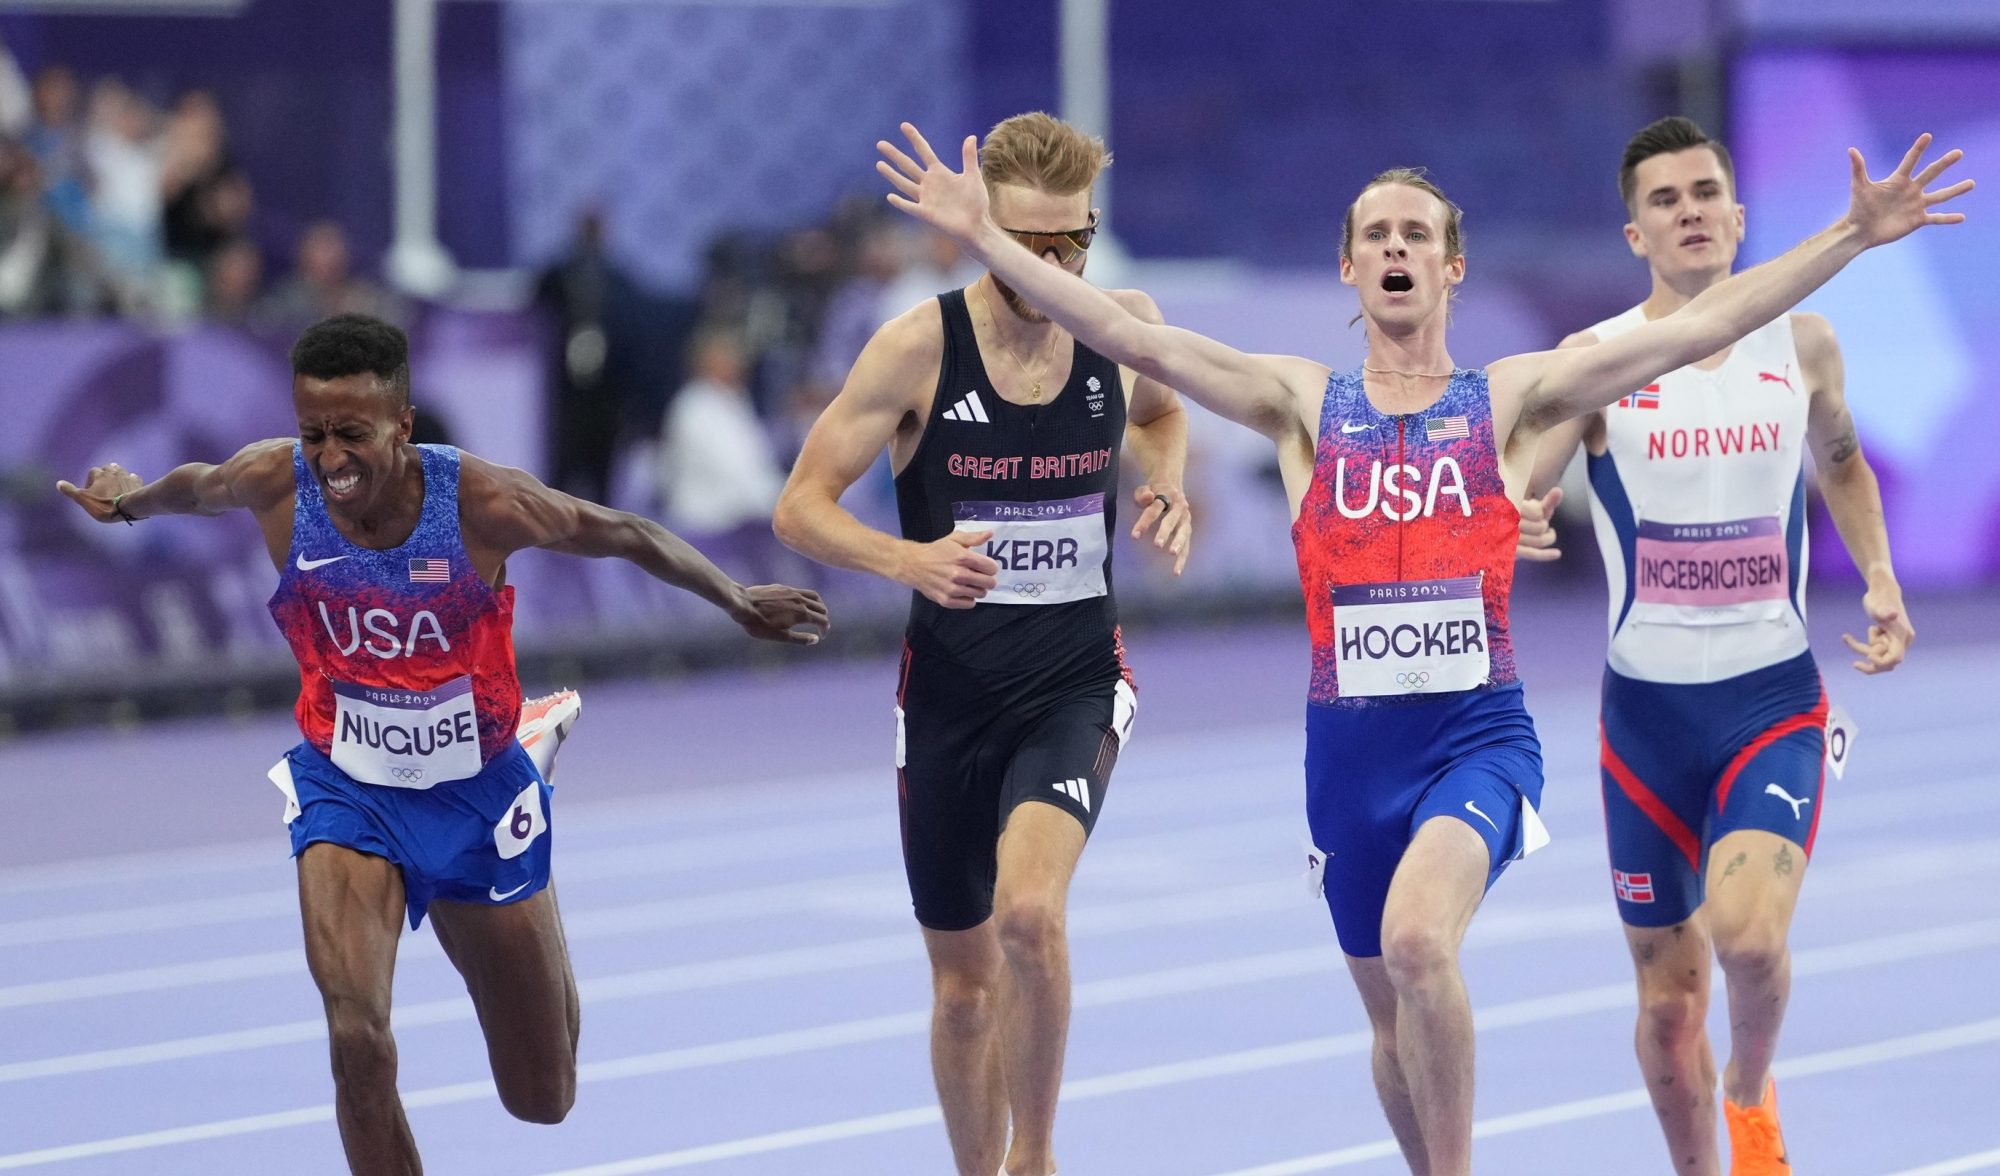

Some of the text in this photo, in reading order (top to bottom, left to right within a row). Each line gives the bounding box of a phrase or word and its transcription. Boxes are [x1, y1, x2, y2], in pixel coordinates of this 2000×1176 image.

[1648, 422, 1780, 460] NORWAY
[947, 447, 1112, 480] GREAT BRITAIN
[1335, 456, 1472, 521] USA
[1037, 504, 1072, 516] 2024
[1673, 524, 1749, 538] PARIS 2024
[986, 537, 1078, 571] KERR
[1641, 553, 1781, 590] INGEBRIGTSEN
[1369, 584, 1447, 599] PARIS 2024
[318, 600, 451, 659] USA
[1341, 619, 1484, 661] HOCKER
[405, 694, 436, 706] 2024
[341, 710, 475, 756] NUGUSE
[510, 804, 533, 840] 6
